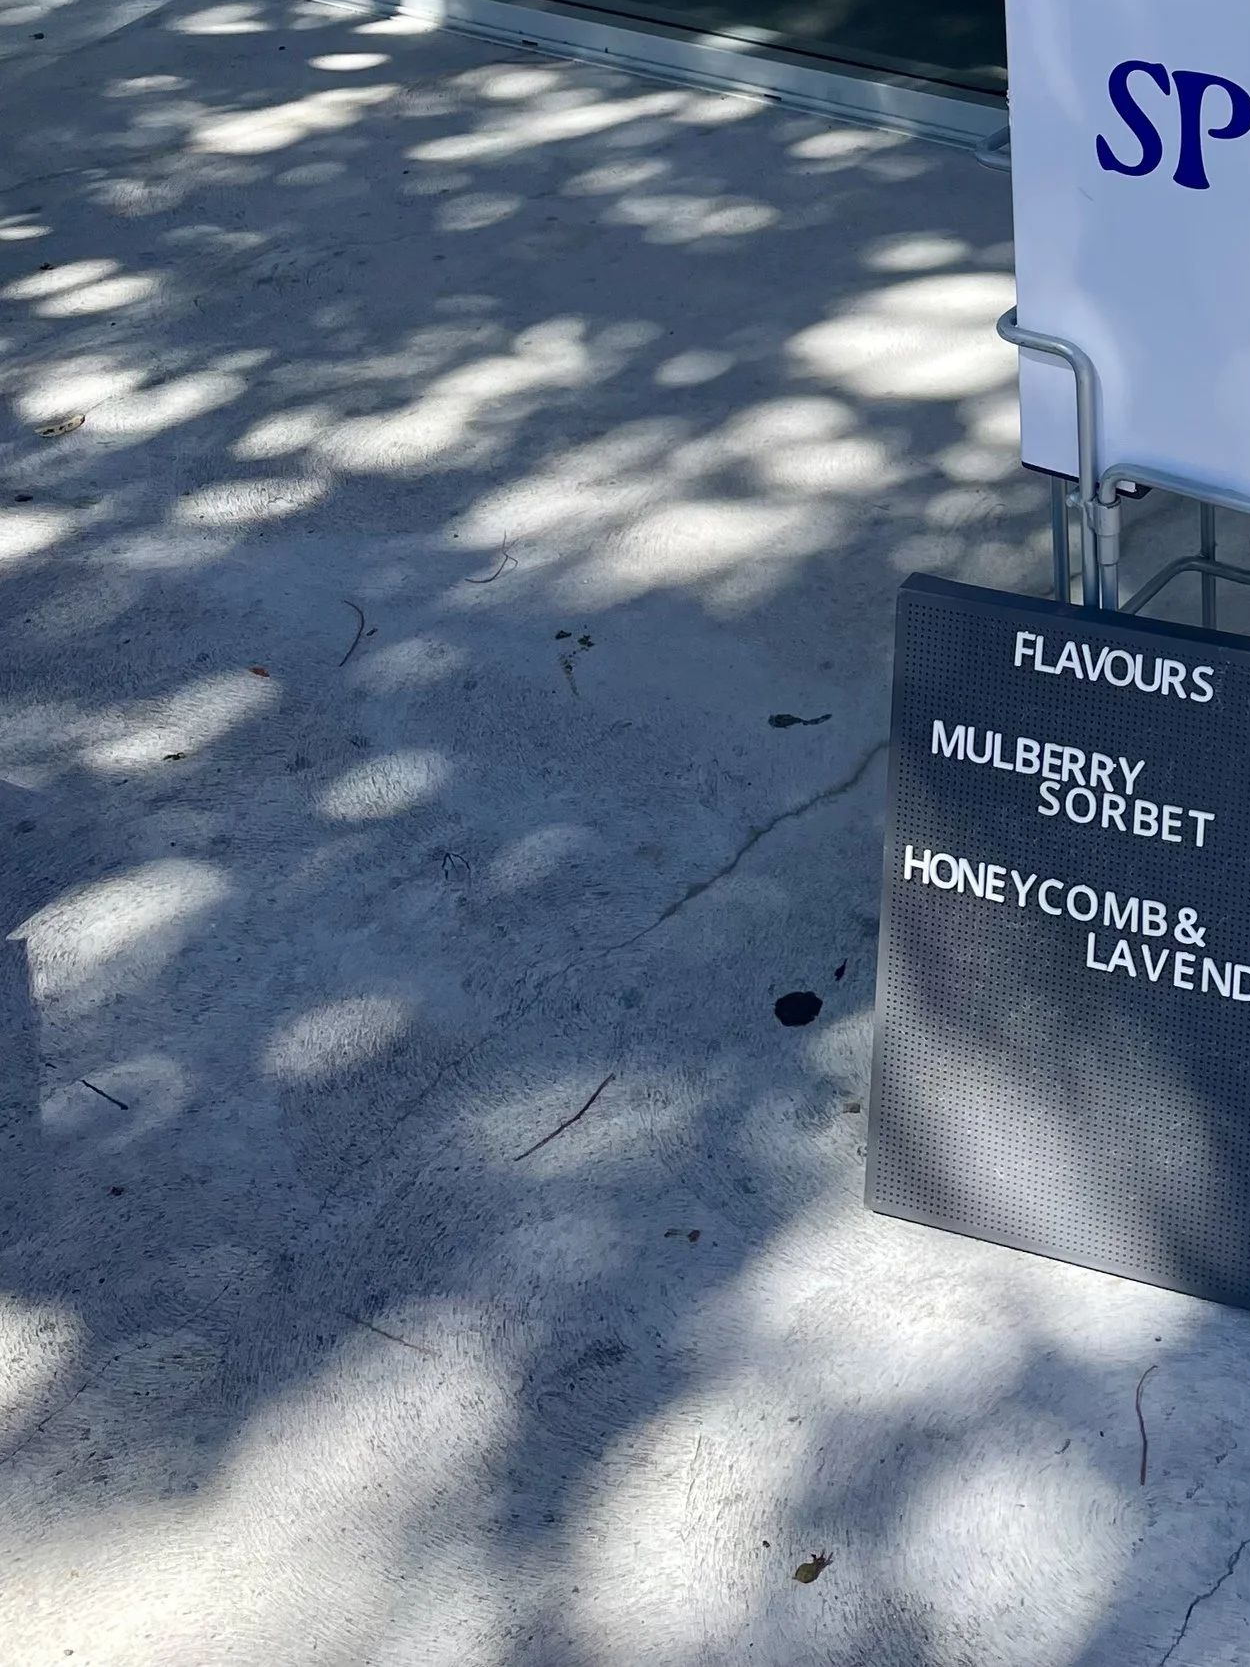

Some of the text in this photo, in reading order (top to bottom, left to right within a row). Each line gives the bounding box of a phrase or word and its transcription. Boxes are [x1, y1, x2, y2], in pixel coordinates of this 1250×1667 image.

[1014, 631, 1215, 703] FLAVOURS
[930, 719, 1146, 795] MULBERRY
[1037, 780, 1216, 848] SORBET
